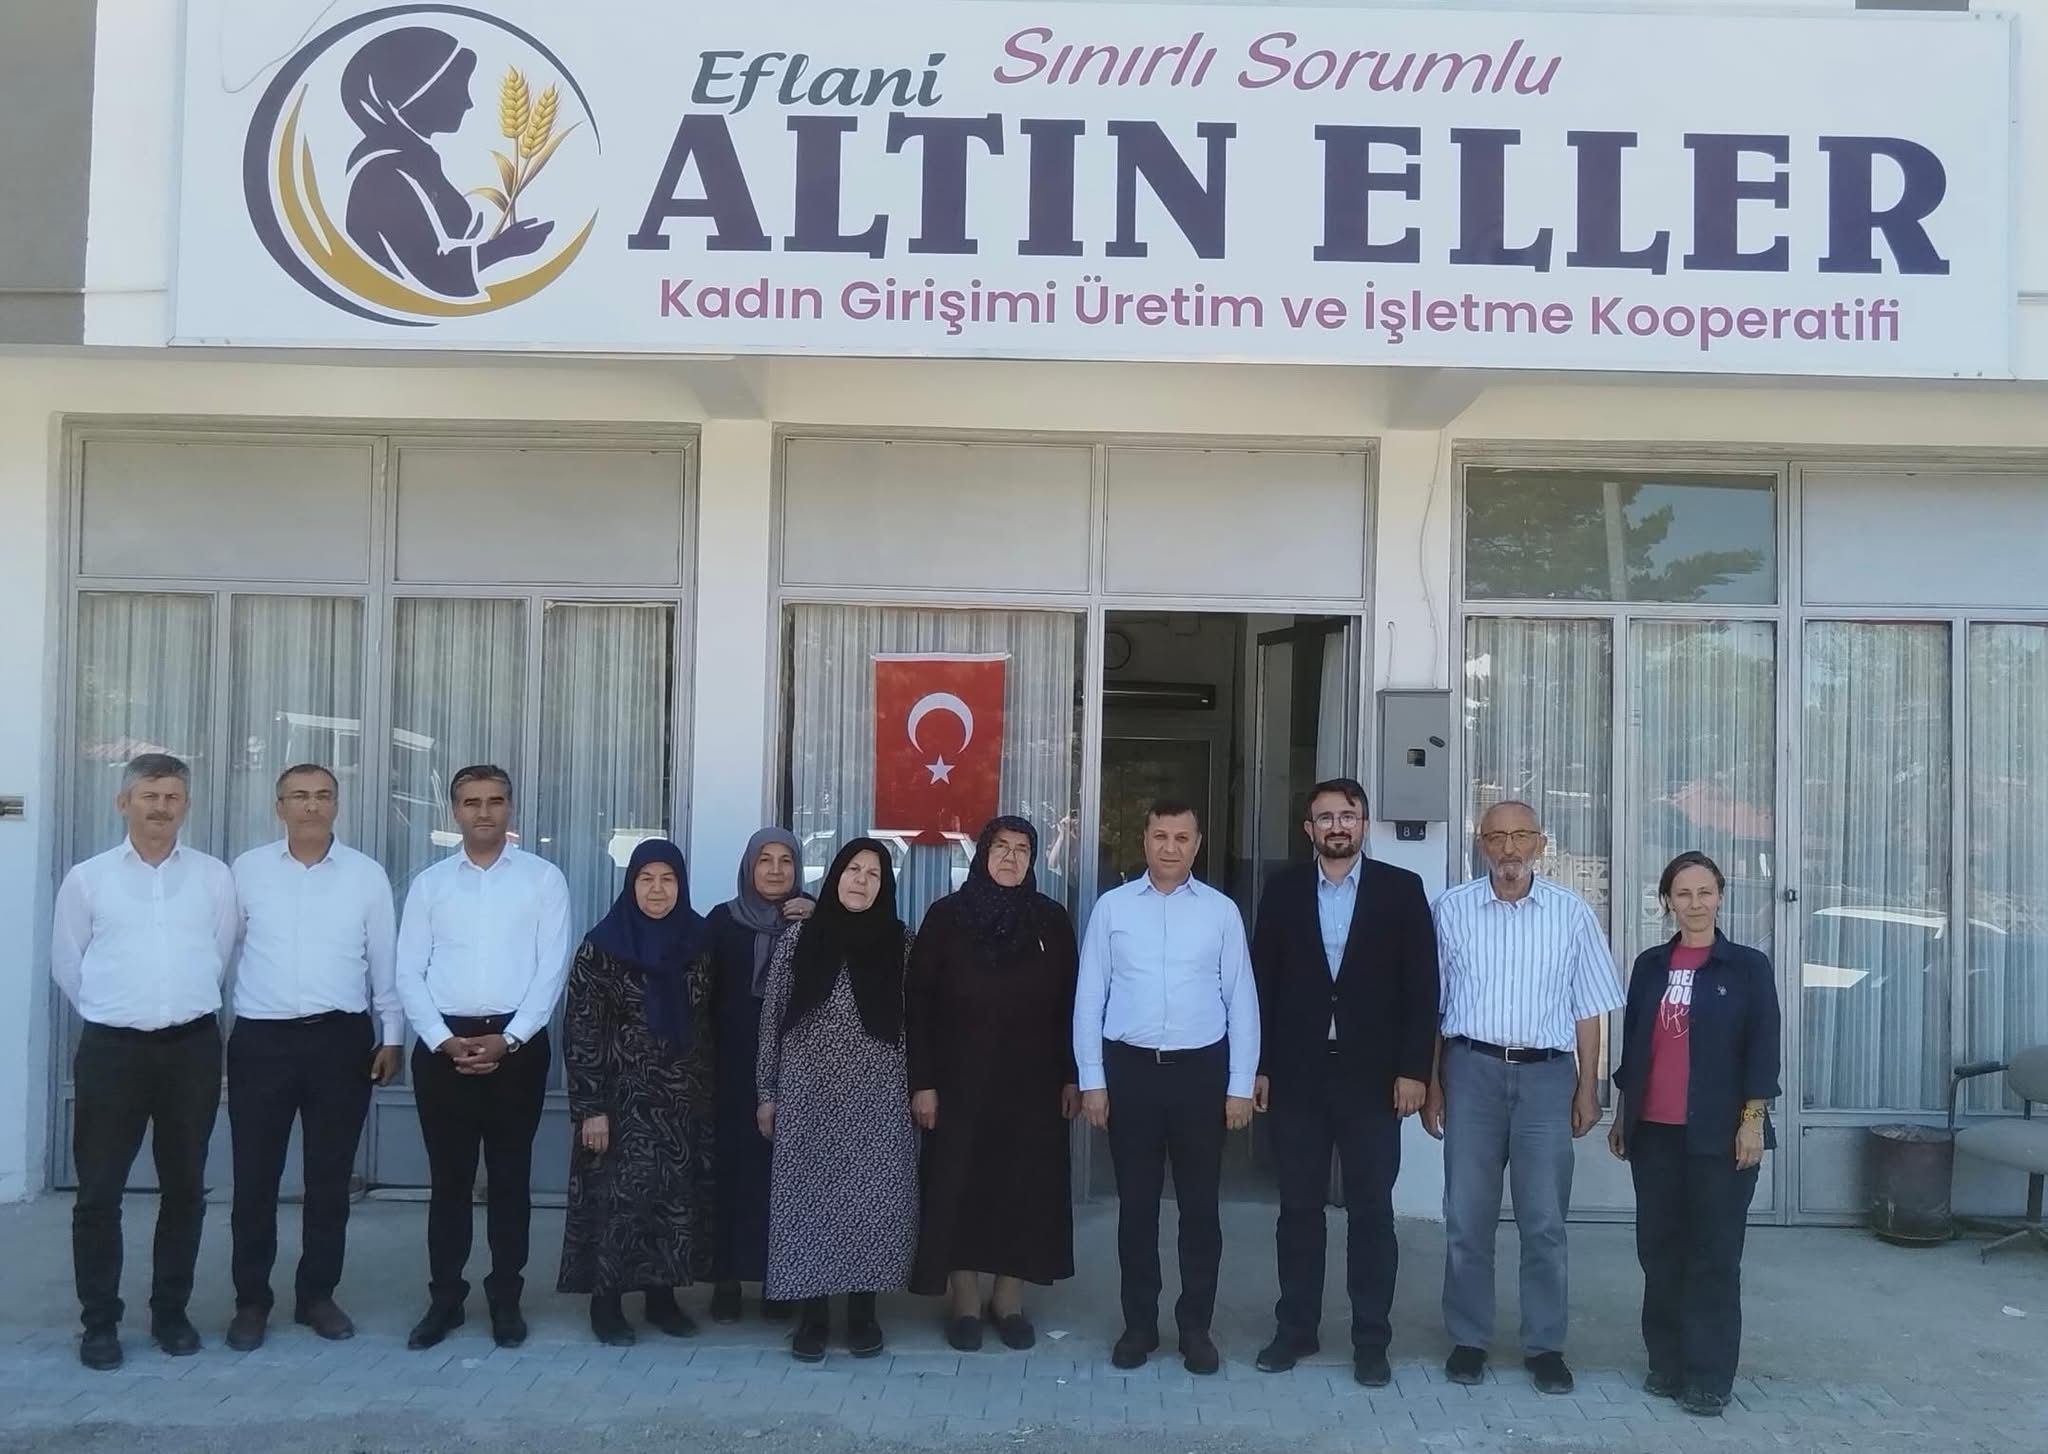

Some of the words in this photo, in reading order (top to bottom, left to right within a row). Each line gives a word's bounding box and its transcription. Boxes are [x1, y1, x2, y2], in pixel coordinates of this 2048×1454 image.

[690, 50, 947, 116] Eflani
[993, 27, 1218, 88] Sınırlı
[1237, 31, 1562, 96] Sorumlu
[627, 111, 1238, 260] ALTIN
[1312, 123, 1951, 276] ELLER
[660, 277, 823, 320] Kadın
[840, 277, 1057, 336] Girişimi
[1075, 274, 1264, 328] Üretim
[1280, 297, 1347, 330] ve
[1365, 280, 1574, 345] İşletme
[1591, 296, 1900, 351] Kooperatifi
